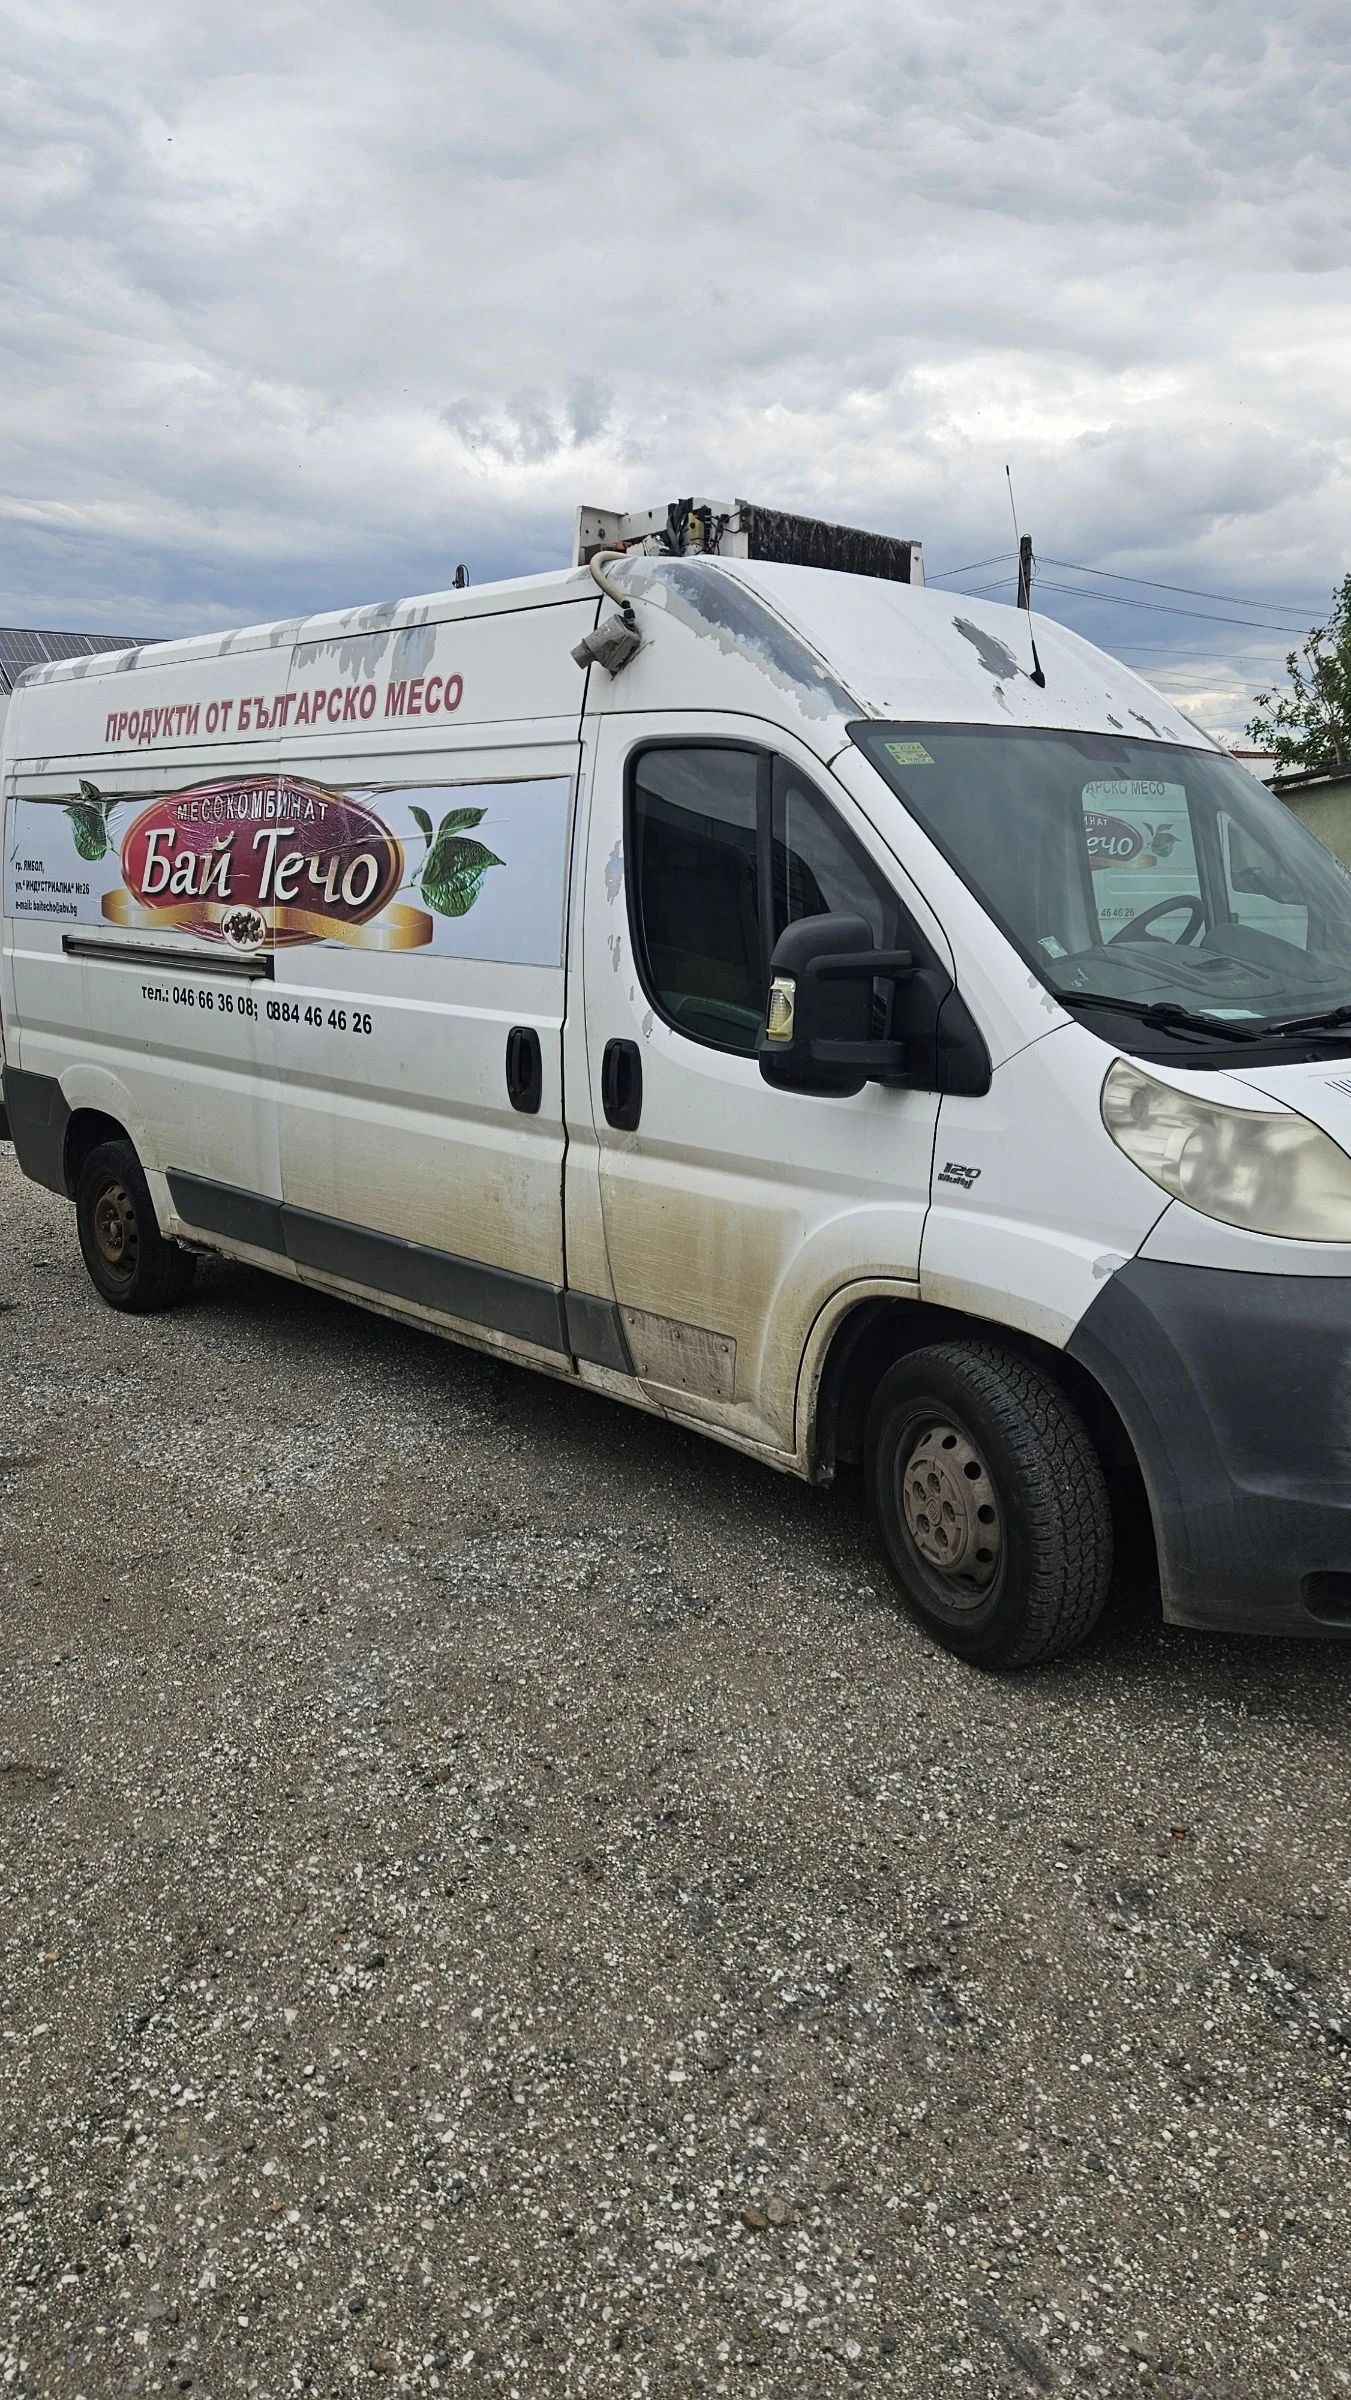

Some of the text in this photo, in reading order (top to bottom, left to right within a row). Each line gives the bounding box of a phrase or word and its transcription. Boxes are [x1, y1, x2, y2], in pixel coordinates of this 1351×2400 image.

[105, 673, 465, 744] ПРОДУКТИ ОТ БЪЛГАРСКО МЕСО
[1131, 781, 1165, 796] МЕСО
[176, 789, 329, 821] МЕСОКОМБИНАТ
[23, 860, 45, 874] ЯМБОЛ,
[141, 827, 378, 905] Бай Течо
[1113, 908, 1123, 917] 46
[1124, 907, 1135, 917] 26
[142, 986, 169, 1003] тел.:
[173, 986, 195, 1007] 046
[198, 990, 214, 1009] 66
[217, 993, 234, 1013] 36
[266, 1001, 300, 1023] 0884
[304, 1005, 323, 1027] 46
[327, 1009, 347, 1031] 46
[352, 1012, 373, 1035] 26
[943, 1162, 982, 1179] 120
